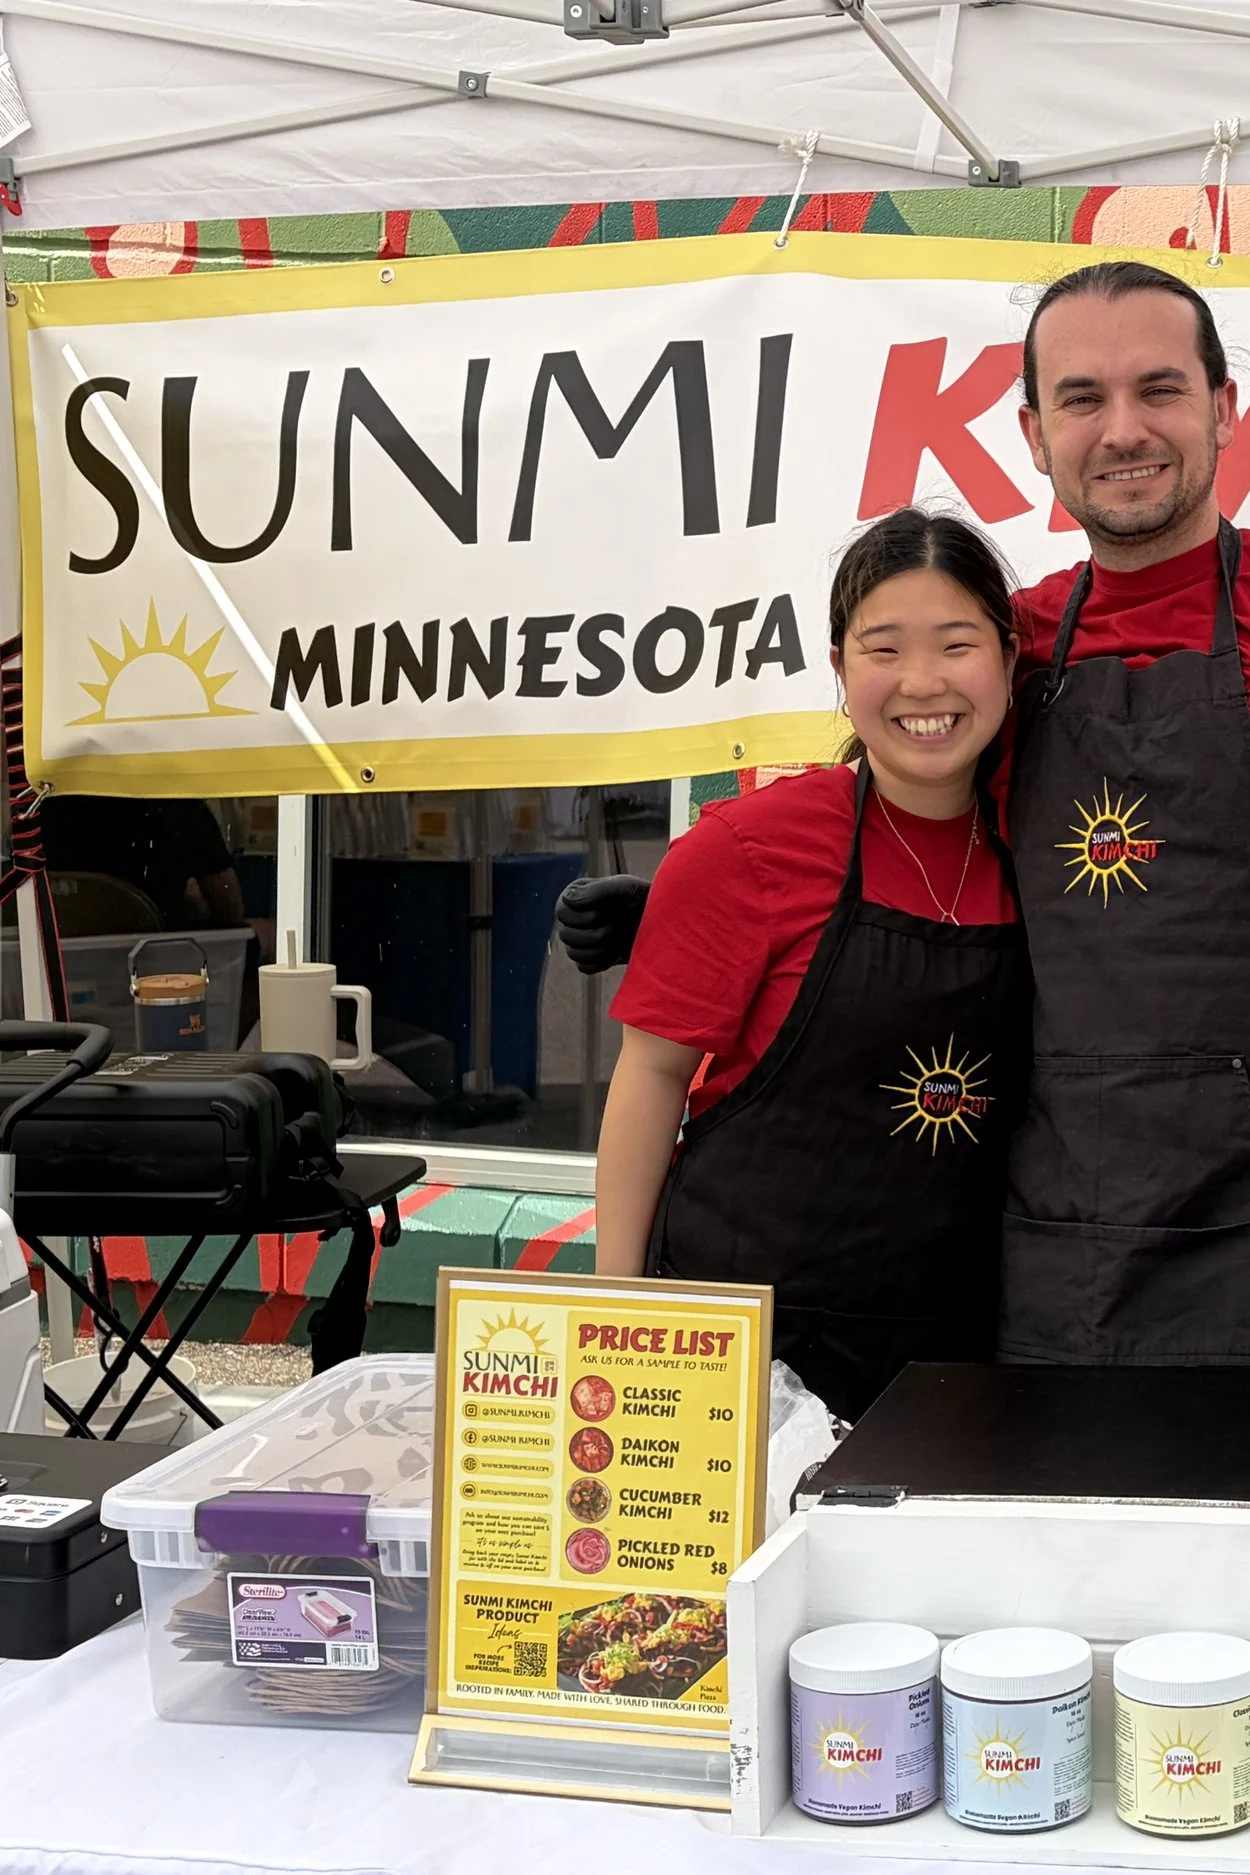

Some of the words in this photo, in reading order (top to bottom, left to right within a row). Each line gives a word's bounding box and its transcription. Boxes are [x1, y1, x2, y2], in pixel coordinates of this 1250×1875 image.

[65, 332, 793, 574] SUNMI
[270, 593, 807, 710] MINNESOTA
[1091, 831, 1121, 844] SUNMI
[1091, 842, 1159, 862] KIMCHI
[923, 1081, 960, 1095] SUNMI
[578, 1323, 668, 1354] PRICE
[672, 1329, 735, 1357] LIST
[463, 1351, 539, 1374] SUNMI
[580, 1354, 598, 1364] ASK
[601, 1356, 613, 1365] US
[615, 1356, 634, 1366] FOR
[636, 1358, 644, 1367] A
[647, 1358, 680, 1369] SAMPLE
[684, 1361, 697, 1370] TO
[700, 1361, 728, 1372] TASTE!
[462, 1371, 559, 1398] KIMCHI
[623, 1386, 682, 1402] CLASSIC
[622, 1402, 676, 1418] KIMCHI
[708, 1406, 734, 1421] $10
[621, 1437, 680, 1453] DAIKON
[620, 1453, 674, 1469] KIMCHI
[706, 1458, 732, 1472] $10
[619, 1488, 702, 1506] CUCUMBER
[618, 1504, 672, 1520] KIMCHI
[708, 1509, 729, 1523] $12
[617, 1539, 681, 1556] PICKLED
[684, 1544, 715, 1558] RED
[617, 1555, 675, 1571] ONIONS
[711, 1560, 728, 1575] $8
[243, 1585, 281, 1597] Sterilite
[463, 1594, 503, 1608] SUNMI
[506, 1597, 553, 1612] KIMCHI
[476, 1608, 540, 1624] PRODUCT
[487, 1622, 522, 1640] Ideas
[456, 1683, 492, 1695] ROOTED
[493, 1686, 503, 1696] IN
[537, 1690, 561, 1700] MADE
[564, 1692, 587, 1703] WITH
[615, 1697, 649, 1708] SHARED
[651, 1700, 696, 1712] THROUGH
[698, 1704, 727, 1715] FOOD.
[826, 1739, 854, 1749] SUNMI
[827, 1748, 883, 1762] KIMCHI
[984, 1749, 1013, 1759] SUNMI
[1165, 1754, 1194, 1763] SUNMI
[985, 1757, 1041, 1772] KIMCHI
[1166, 1760, 1222, 1776] KIMCHI
